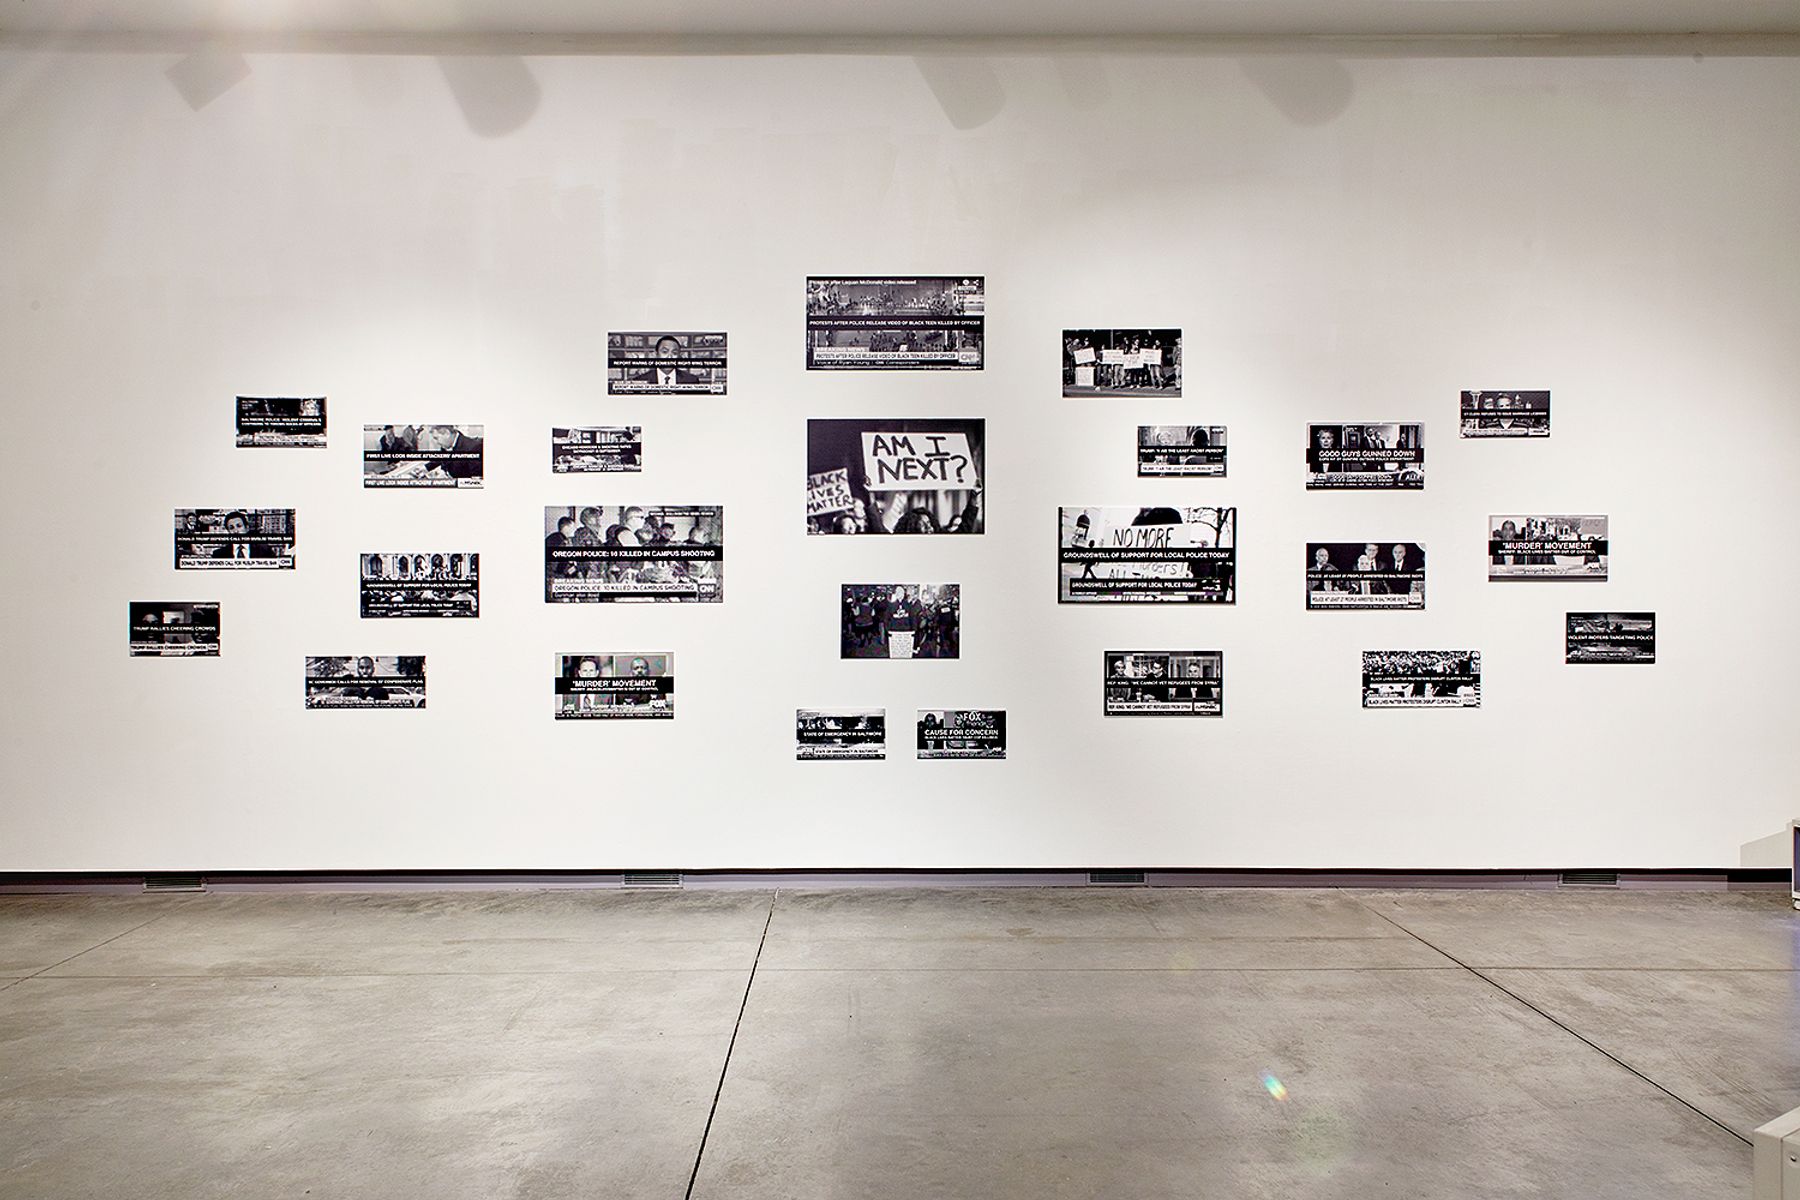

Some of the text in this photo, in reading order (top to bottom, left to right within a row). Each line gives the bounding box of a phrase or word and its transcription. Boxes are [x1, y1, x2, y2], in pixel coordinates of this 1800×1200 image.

[872, 434, 950, 457] AM I
[877, 454, 968, 484] NEXT?
[807, 494, 855, 513] MATTER
[1113, 528, 1133, 548] NO
[1544, 542, 1592, 550] MOVEMENT
[963, 712, 981, 721] FOX
